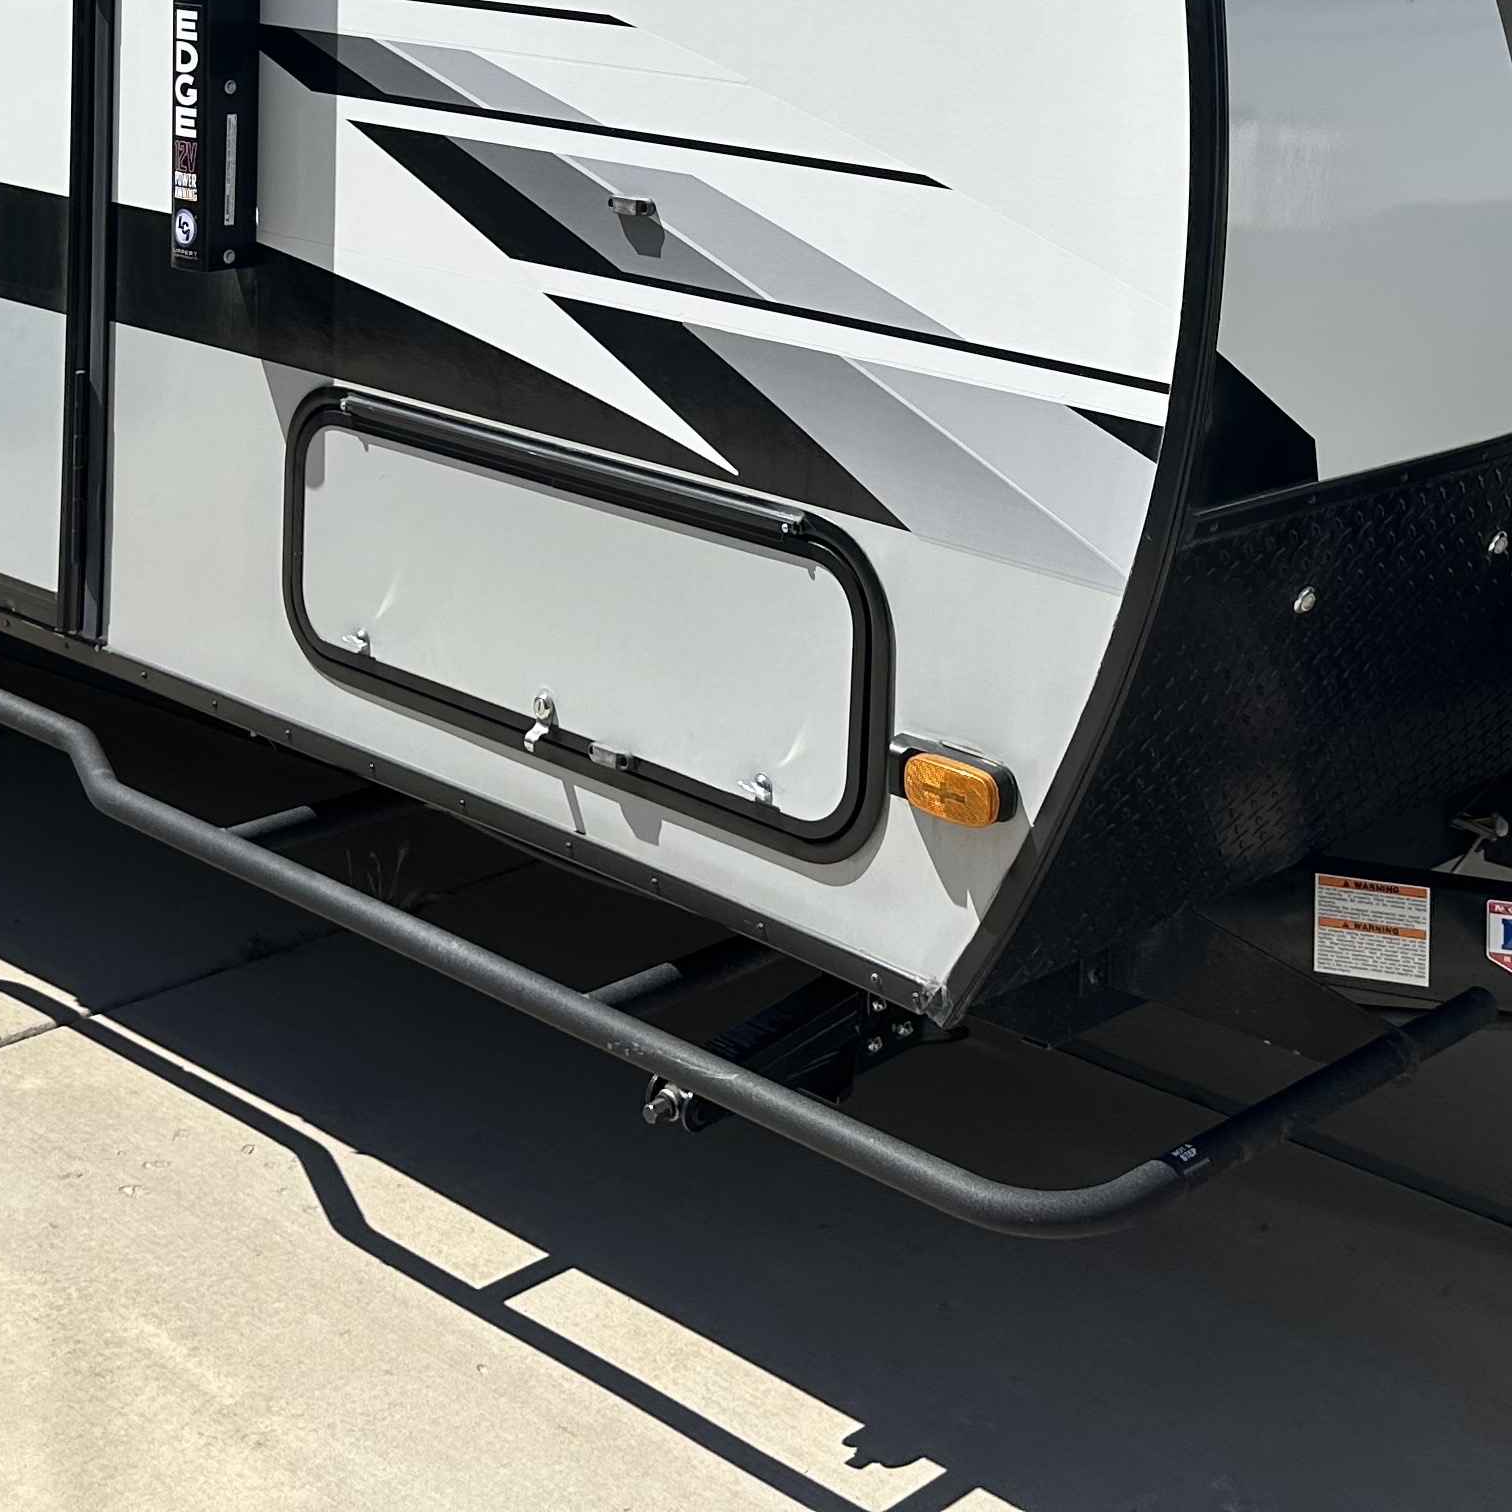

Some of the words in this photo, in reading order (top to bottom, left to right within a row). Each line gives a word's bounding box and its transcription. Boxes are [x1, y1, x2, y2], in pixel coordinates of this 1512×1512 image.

[174, 8, 199, 139] EDGE
[174, 139, 198, 173] 12V
[174, 171, 197, 189] POWER
[1354, 880, 1400, 894] WARNING
[1353, 922, 1399, 936] WARNING
